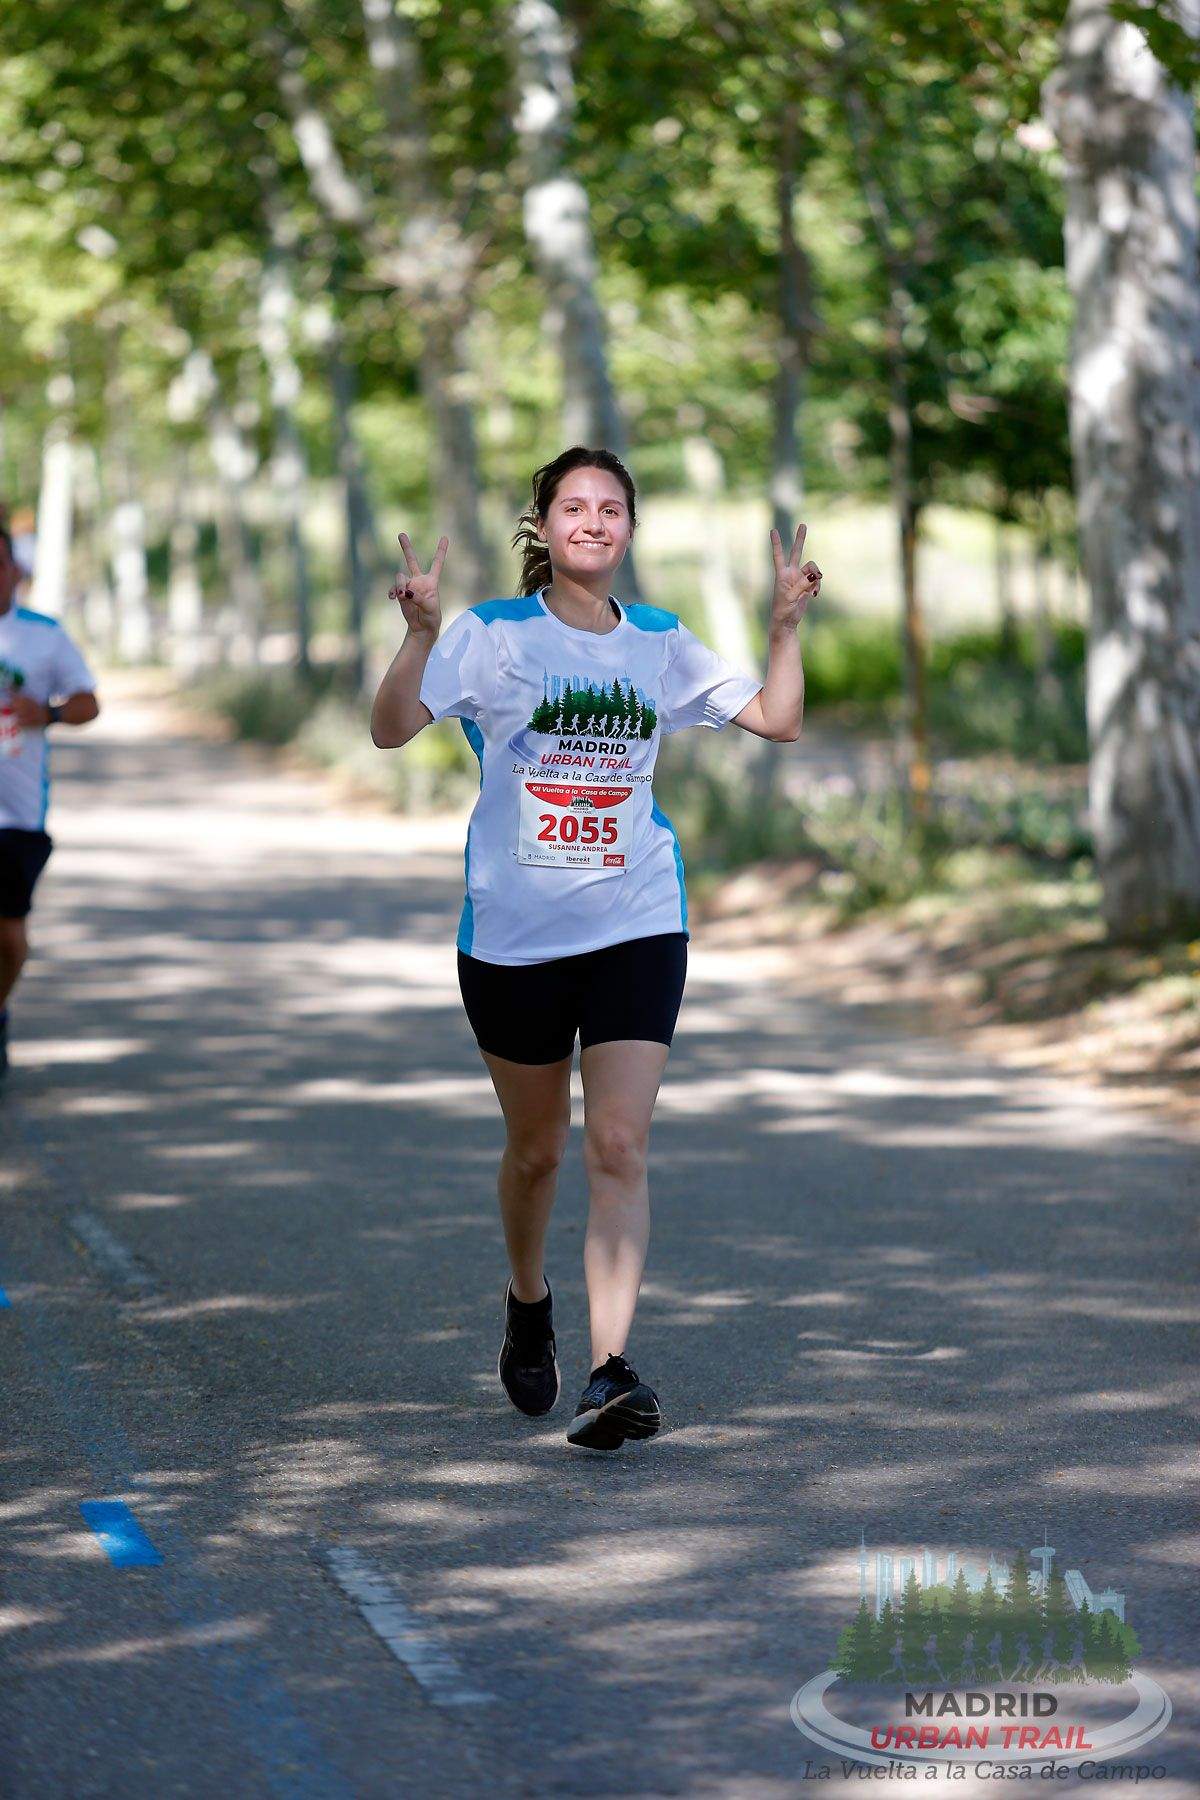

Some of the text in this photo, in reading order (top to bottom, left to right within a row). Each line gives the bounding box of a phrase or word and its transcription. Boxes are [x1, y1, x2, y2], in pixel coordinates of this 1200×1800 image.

[558, 740, 627, 755] MADRID
[541, 754, 594, 768] URBAN
[512, 764, 525, 775] La
[528, 766, 559, 779] Vuelta
[572, 771, 582, 781] la
[542, 786, 564, 794] Vuelta
[537, 814, 618, 845] 2055
